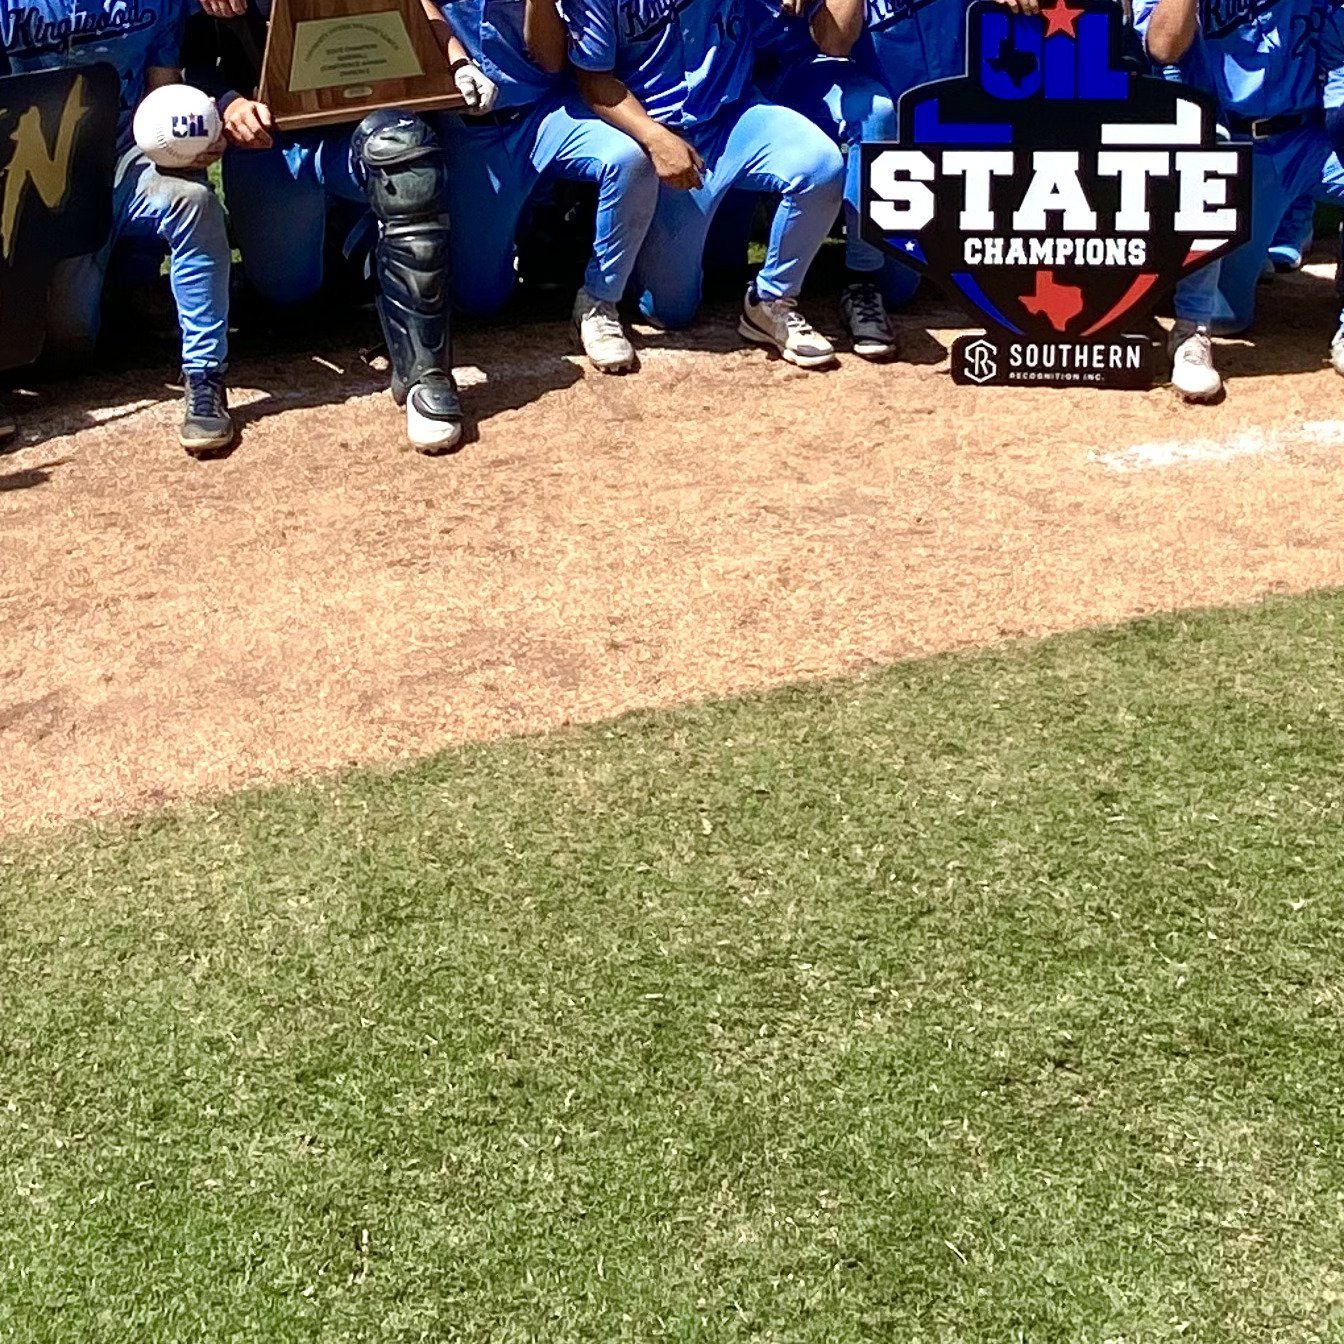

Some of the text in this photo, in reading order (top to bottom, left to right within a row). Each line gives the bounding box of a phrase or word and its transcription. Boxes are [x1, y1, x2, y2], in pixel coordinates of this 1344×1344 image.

[172, 113, 209, 138] UIL
[870, 150, 1238, 231] STATE
[963, 237, 1147, 266] CHAMPIONS
[1009, 344, 1141, 368] SOUTHERN
[1009, 372, 1080, 381] RECOGNITION
